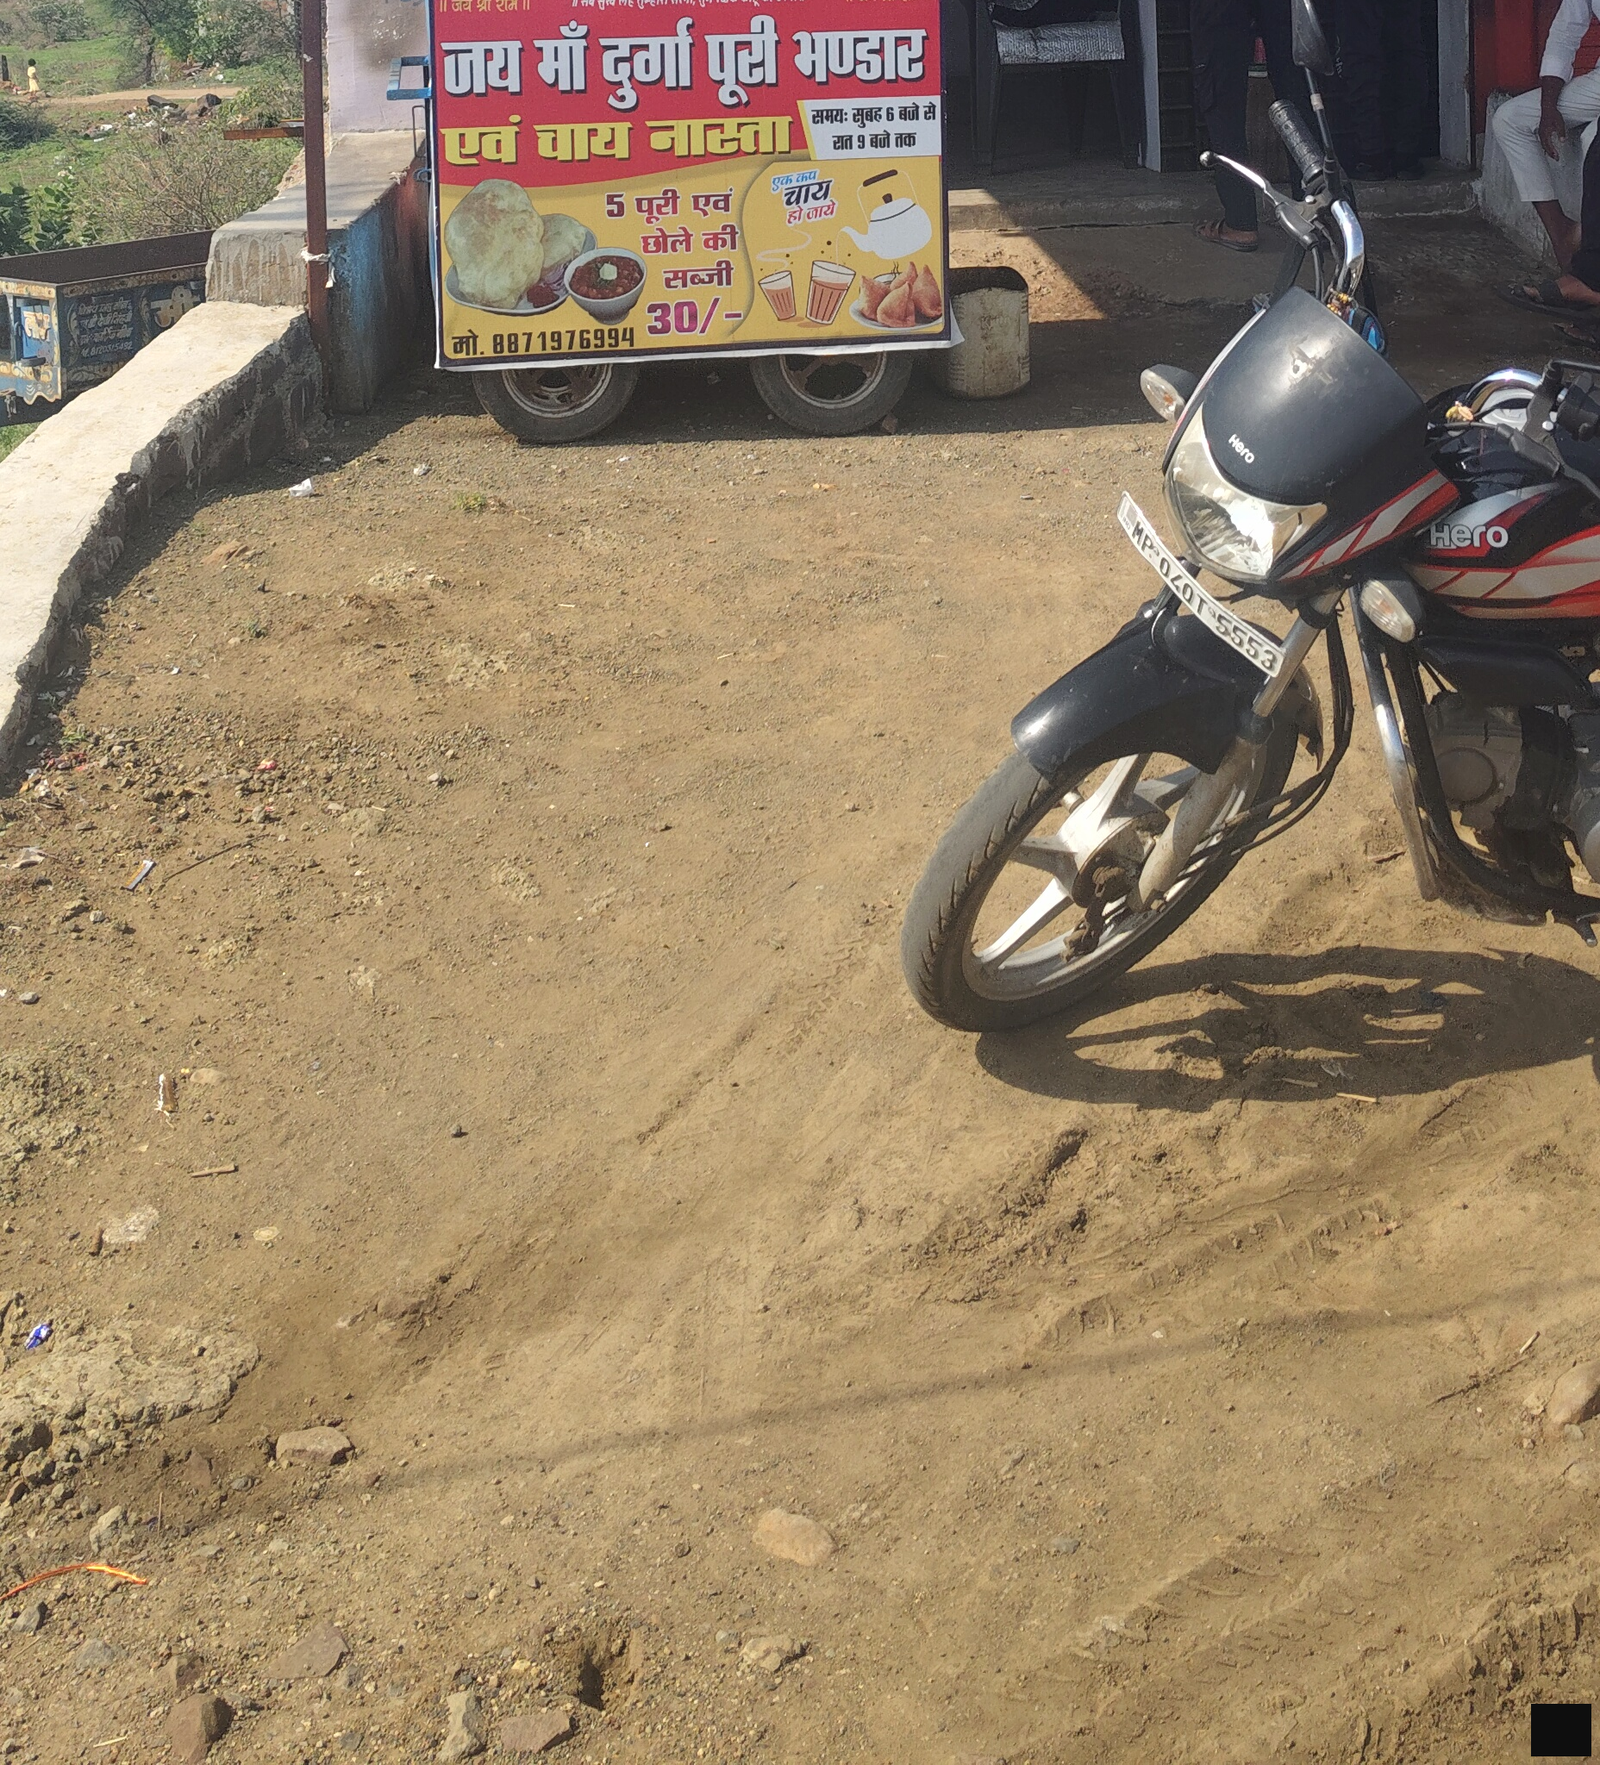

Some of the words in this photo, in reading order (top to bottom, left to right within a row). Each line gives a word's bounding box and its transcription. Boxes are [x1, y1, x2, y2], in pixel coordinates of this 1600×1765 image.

[451, 0, 473, 12] जय
[440, 41, 523, 96] जय
[532, 20, 588, 92] माँ
[598, 17, 694, 111] दुर्गा
[704, 14, 779, 106] पूरी
[792, 29, 927, 83] भण्डार
[852, 107, 882, 128] सुबह
[885, 107, 894, 121] 6
[898, 102, 919, 121] बजे
[923, 101, 936, 120] से
[440, 114, 522, 165] एवं
[533, 122, 633, 161] चाय
[645, 116, 793, 157] नास्ता
[832, 135, 853, 150] रात
[857, 135, 865, 149] 9
[869, 130, 890, 148] बजे
[894, 132, 917, 147] तक
[772, 175, 793, 191] एक
[784, 180, 832, 206] चाय
[606, 193, 625, 217] 5
[635, 189, 680, 224] पूरी
[692, 187, 733, 217] एवं
[788, 206, 803, 224] हो
[641, 228, 693, 253] छोले
[702, 224, 738, 250] की
[663, 260, 734, 289] सब्जी
[647, 297, 742, 335] 30/-
[493, 327, 634, 354] 8871976994
[1228, 433, 1255, 463] Hero
[1430, 524, 1508, 548] Hero
